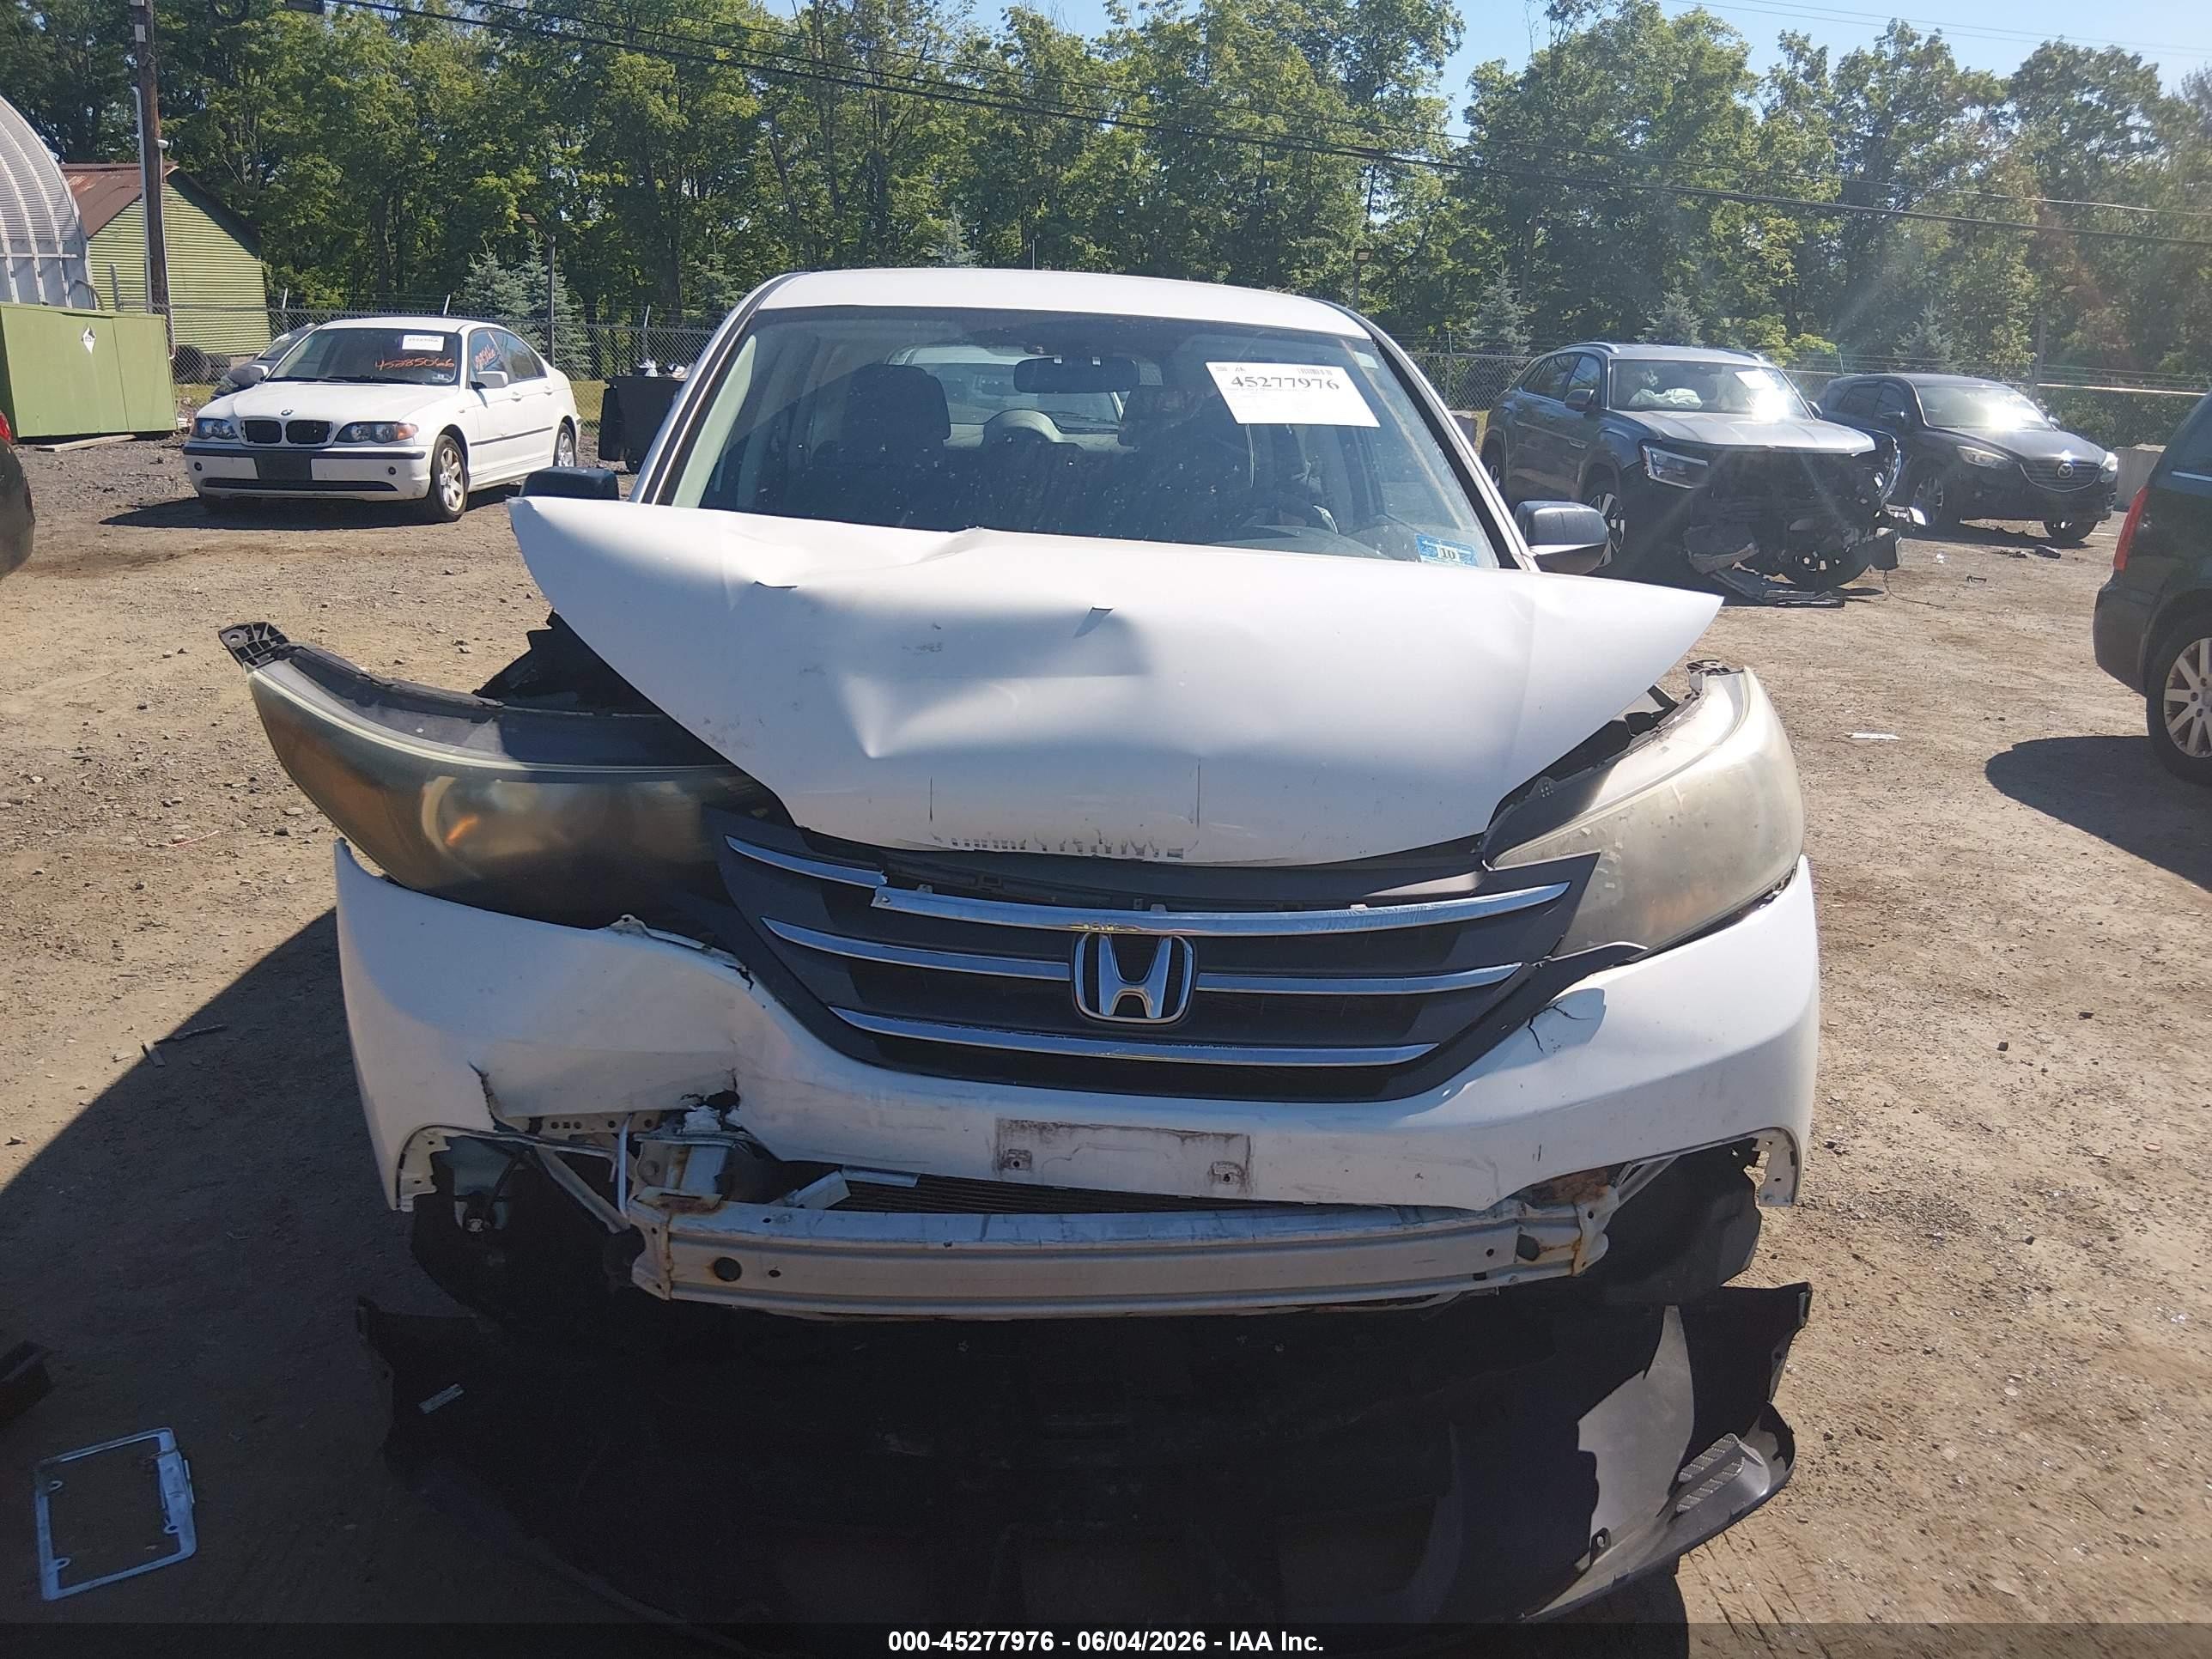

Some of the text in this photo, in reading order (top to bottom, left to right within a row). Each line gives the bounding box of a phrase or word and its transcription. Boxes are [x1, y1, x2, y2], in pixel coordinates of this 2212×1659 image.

[375, 357, 454, 371] 45285066
[1231, 376, 1340, 390] 45277976
[1439, 547, 1456, 560] 10
